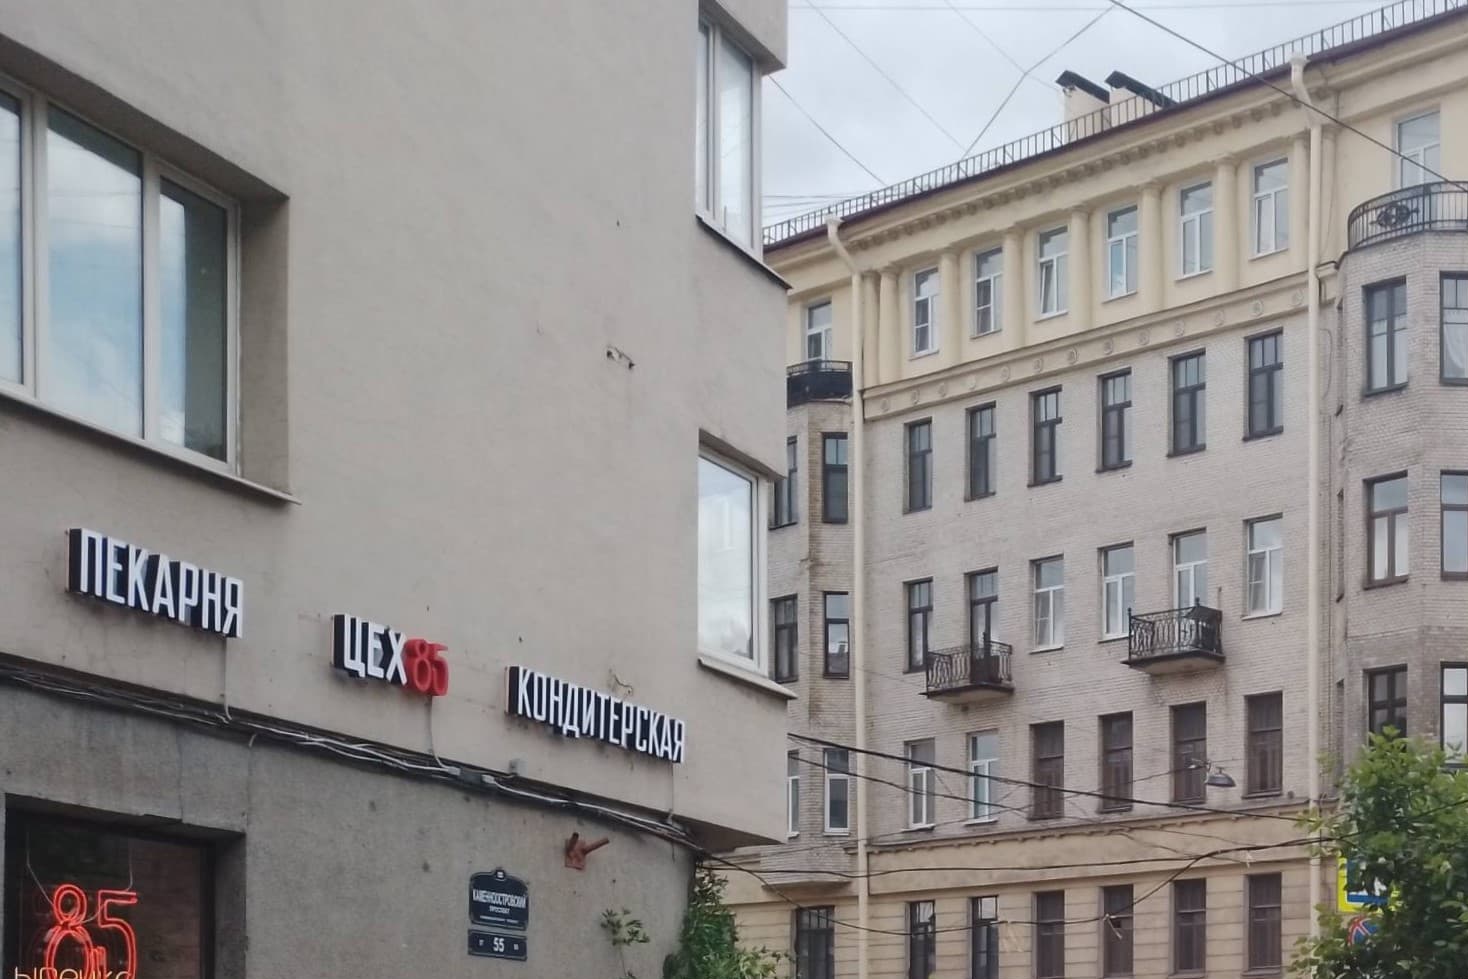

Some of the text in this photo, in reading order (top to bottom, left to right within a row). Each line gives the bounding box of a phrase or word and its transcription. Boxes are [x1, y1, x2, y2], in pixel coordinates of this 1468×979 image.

[78, 527, 244, 638] ПЕКАРНЯ
[517, 665, 686, 764] КОНДИТЕРСКАЯ
[493, 937, 505, 952] 55
